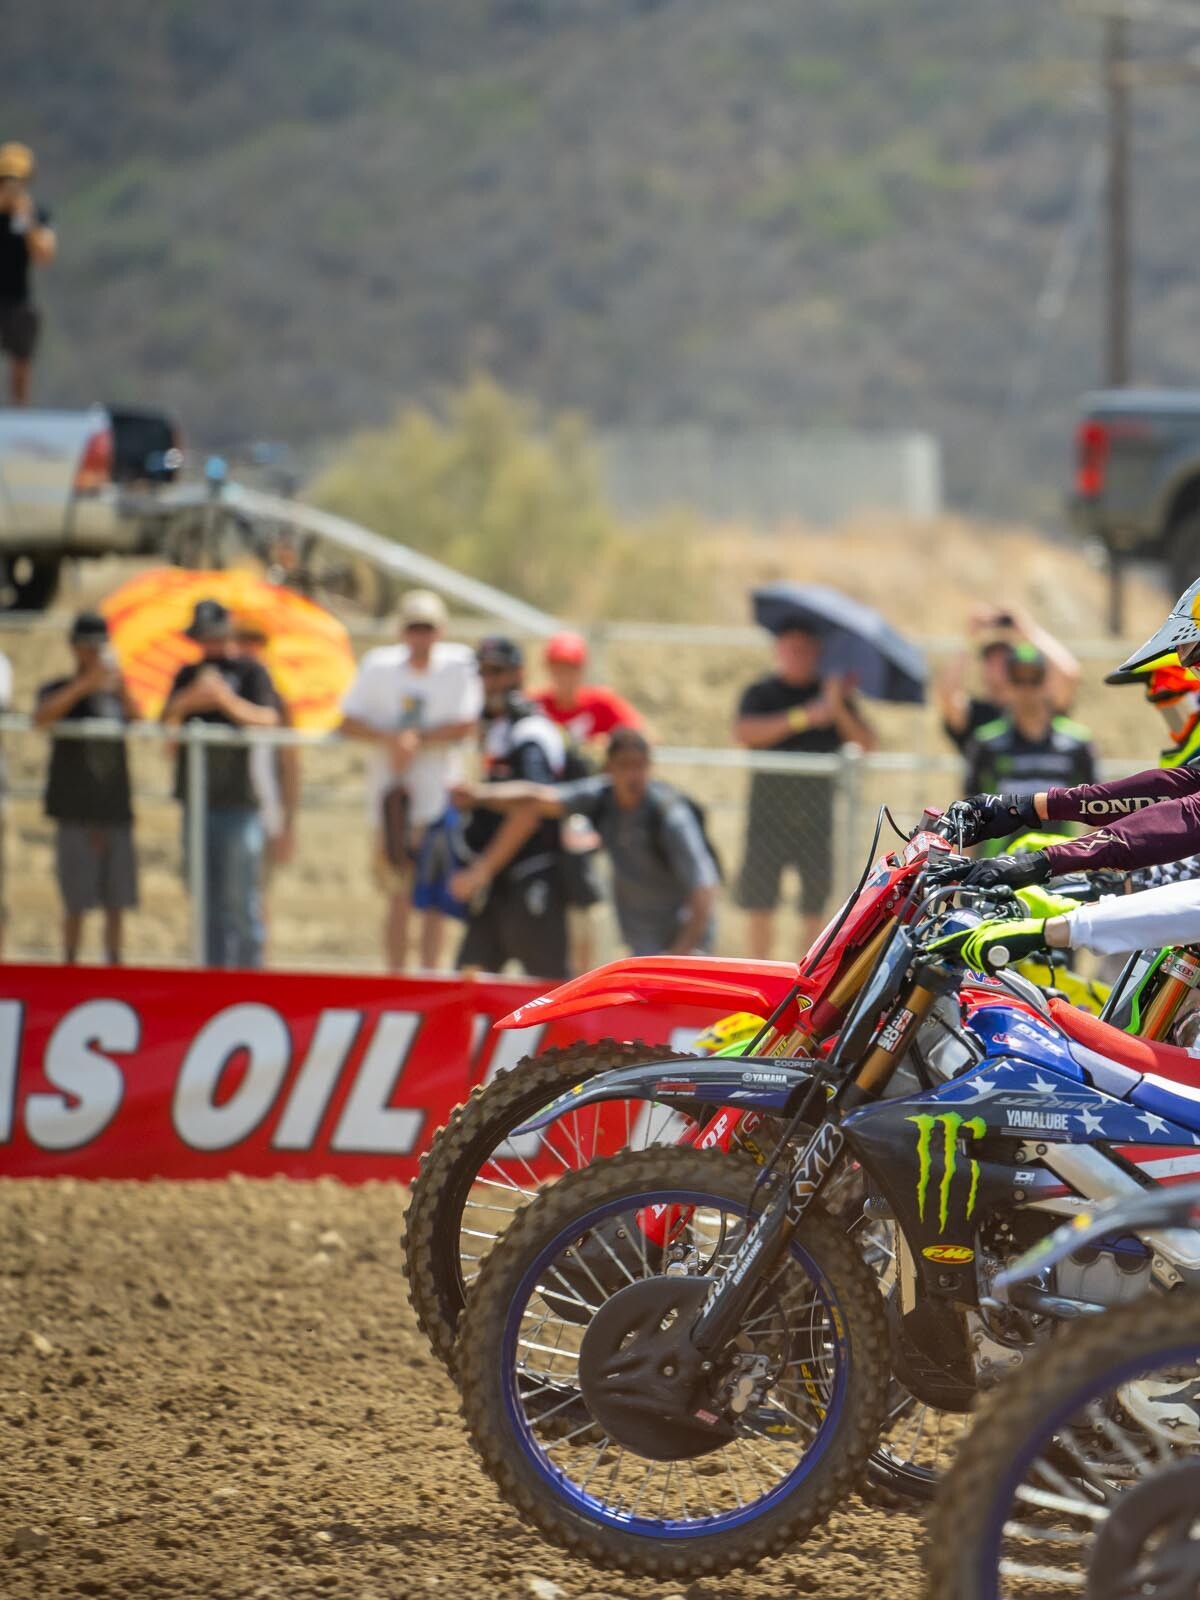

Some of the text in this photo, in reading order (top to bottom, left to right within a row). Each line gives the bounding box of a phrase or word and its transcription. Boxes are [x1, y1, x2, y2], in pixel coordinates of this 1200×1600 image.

[774, 1060, 813, 1068] COOPER
[172, 1001, 429, 1154] OIL
[752, 1072, 788, 1084] YAMAHA
[1006, 1109, 1069, 1131] YAMALUBE
[732, 1239, 763, 1287] BRAKING
